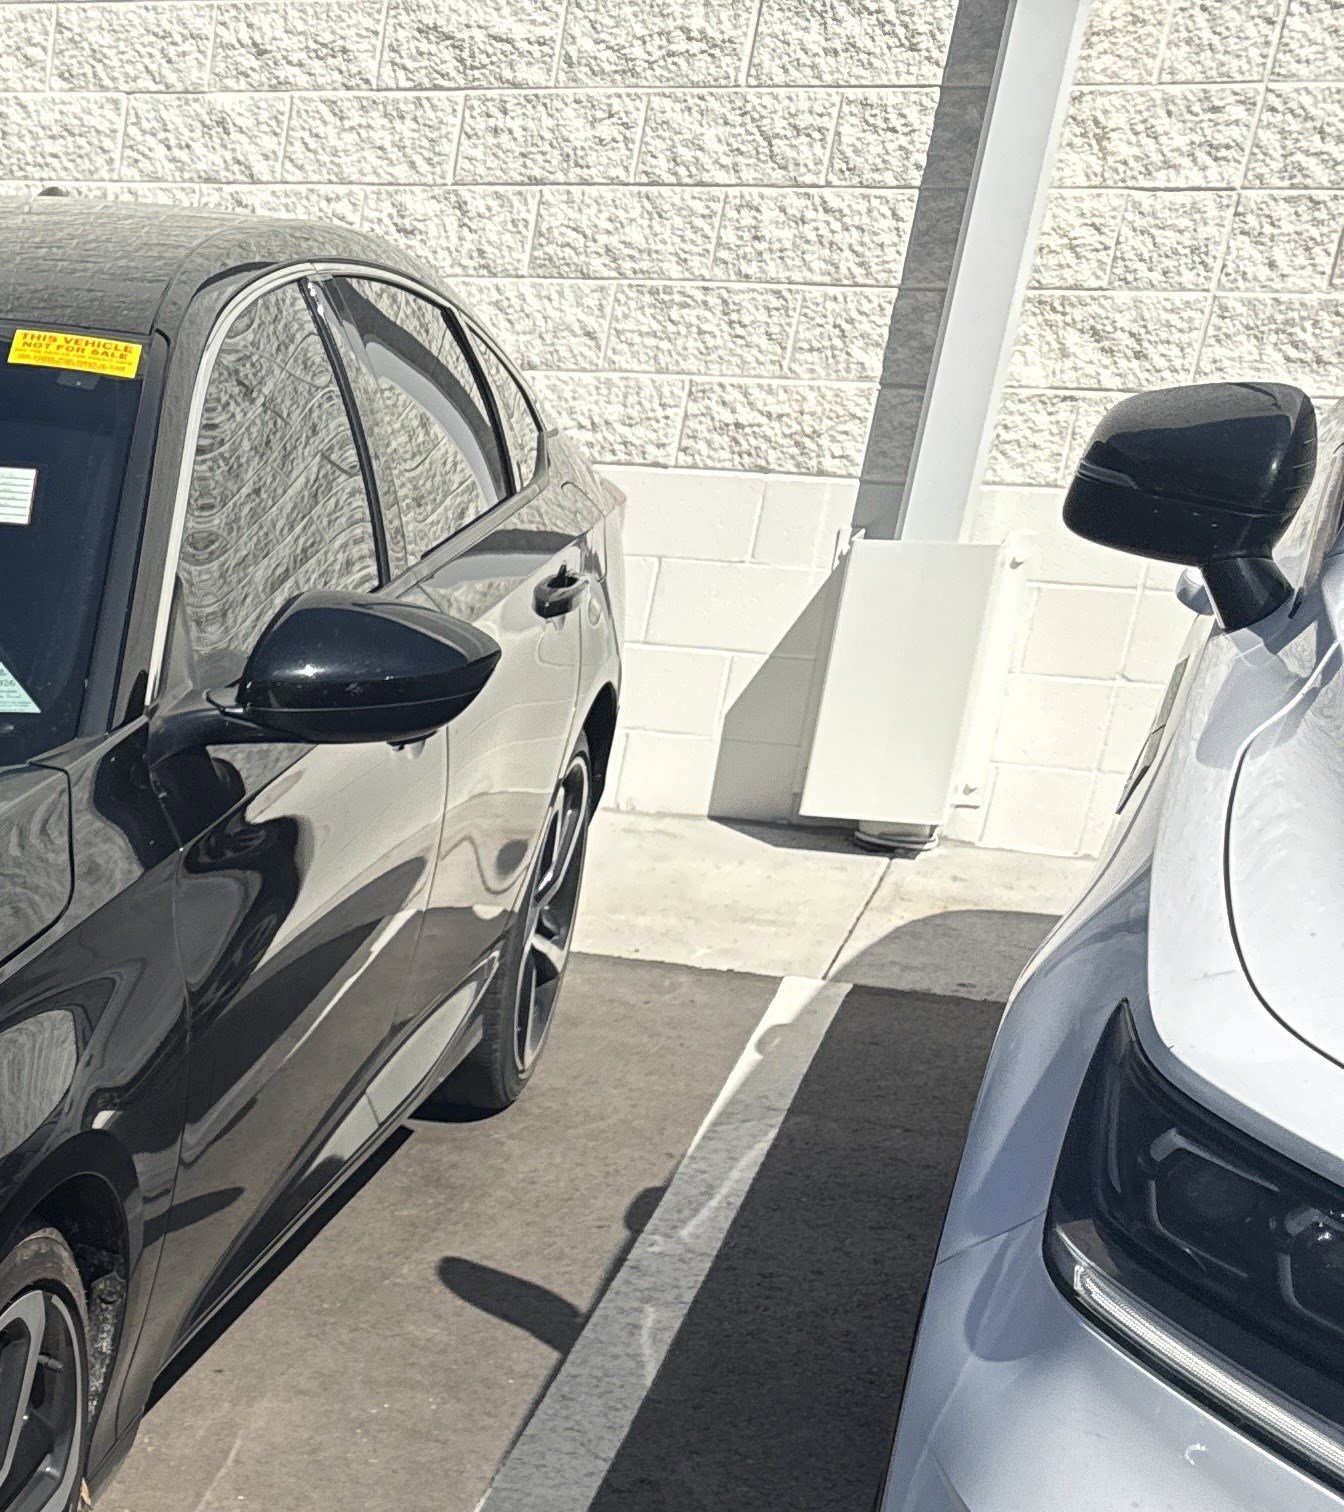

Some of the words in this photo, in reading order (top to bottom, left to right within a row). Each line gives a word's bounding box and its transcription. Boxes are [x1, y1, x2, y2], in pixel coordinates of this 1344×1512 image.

[22, 332, 58, 343] THIS
[64, 337, 133, 353] VEHICLE
[22, 341, 52, 350] NOT
[56, 344, 86, 354] FOR
[90, 349, 129, 360] SALE
